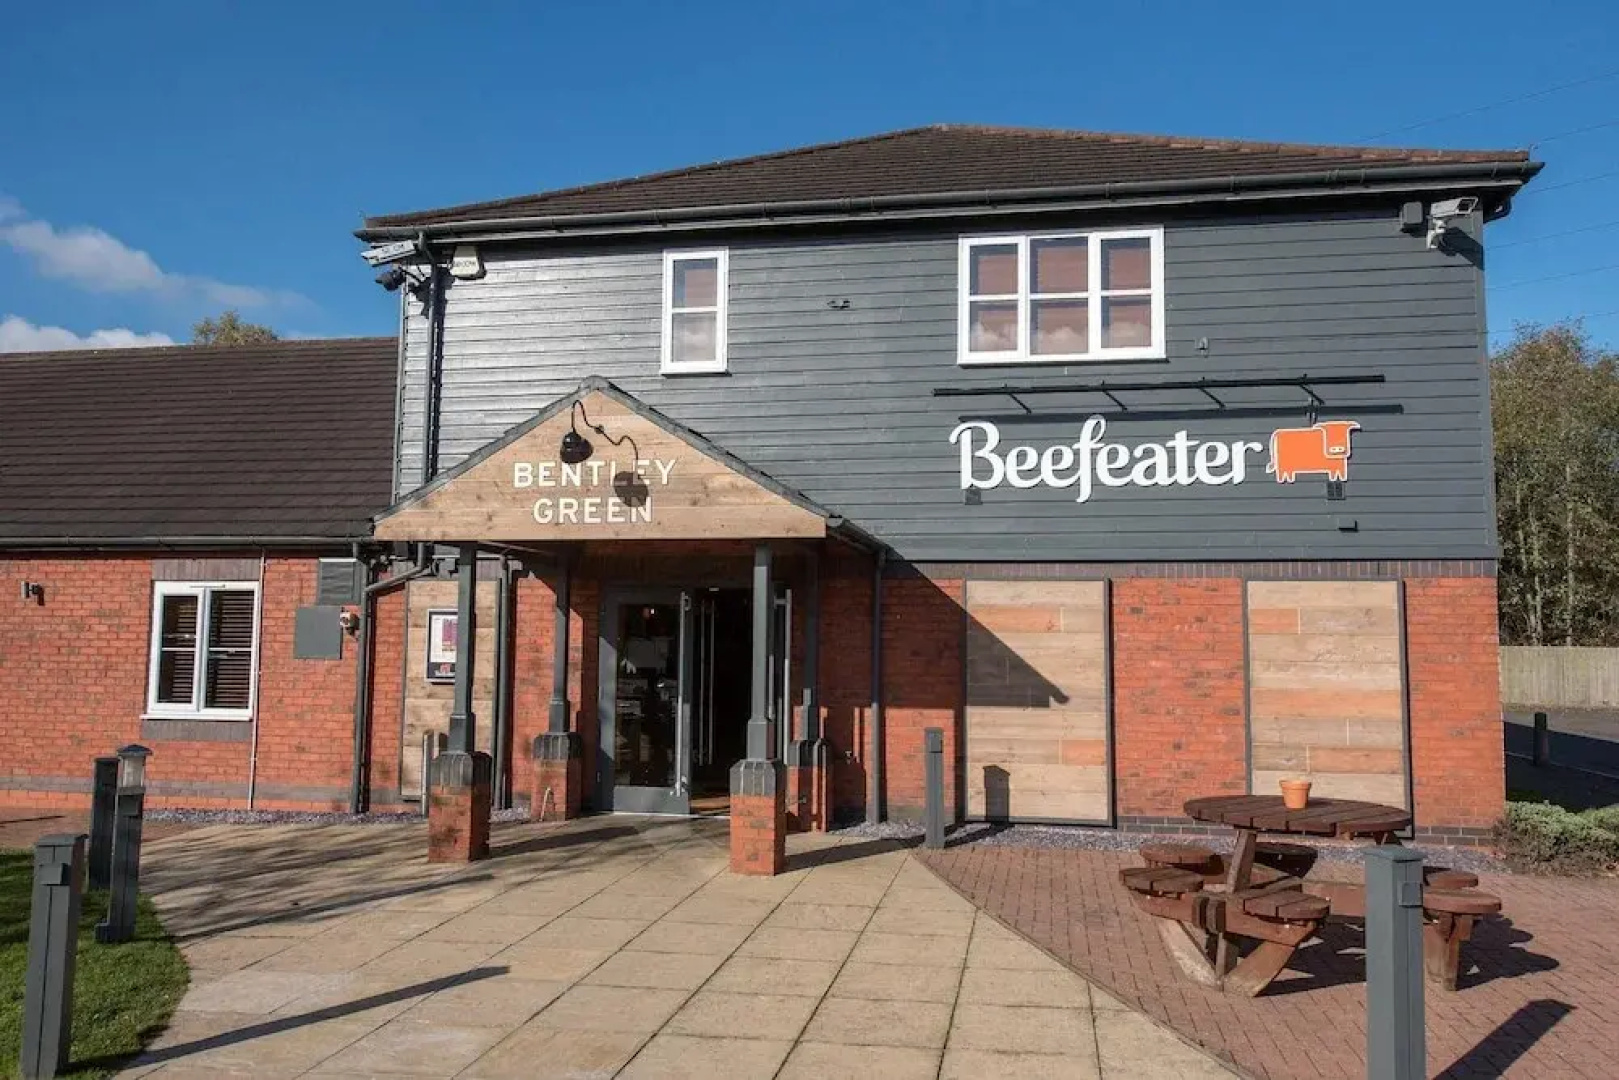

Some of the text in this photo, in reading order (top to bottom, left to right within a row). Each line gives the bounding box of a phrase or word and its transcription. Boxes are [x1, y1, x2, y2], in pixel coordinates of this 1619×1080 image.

[948, 414, 1263, 503] Beefeater
[513, 459, 675, 488] BENTLEY
[533, 497, 653, 525] GREEN
